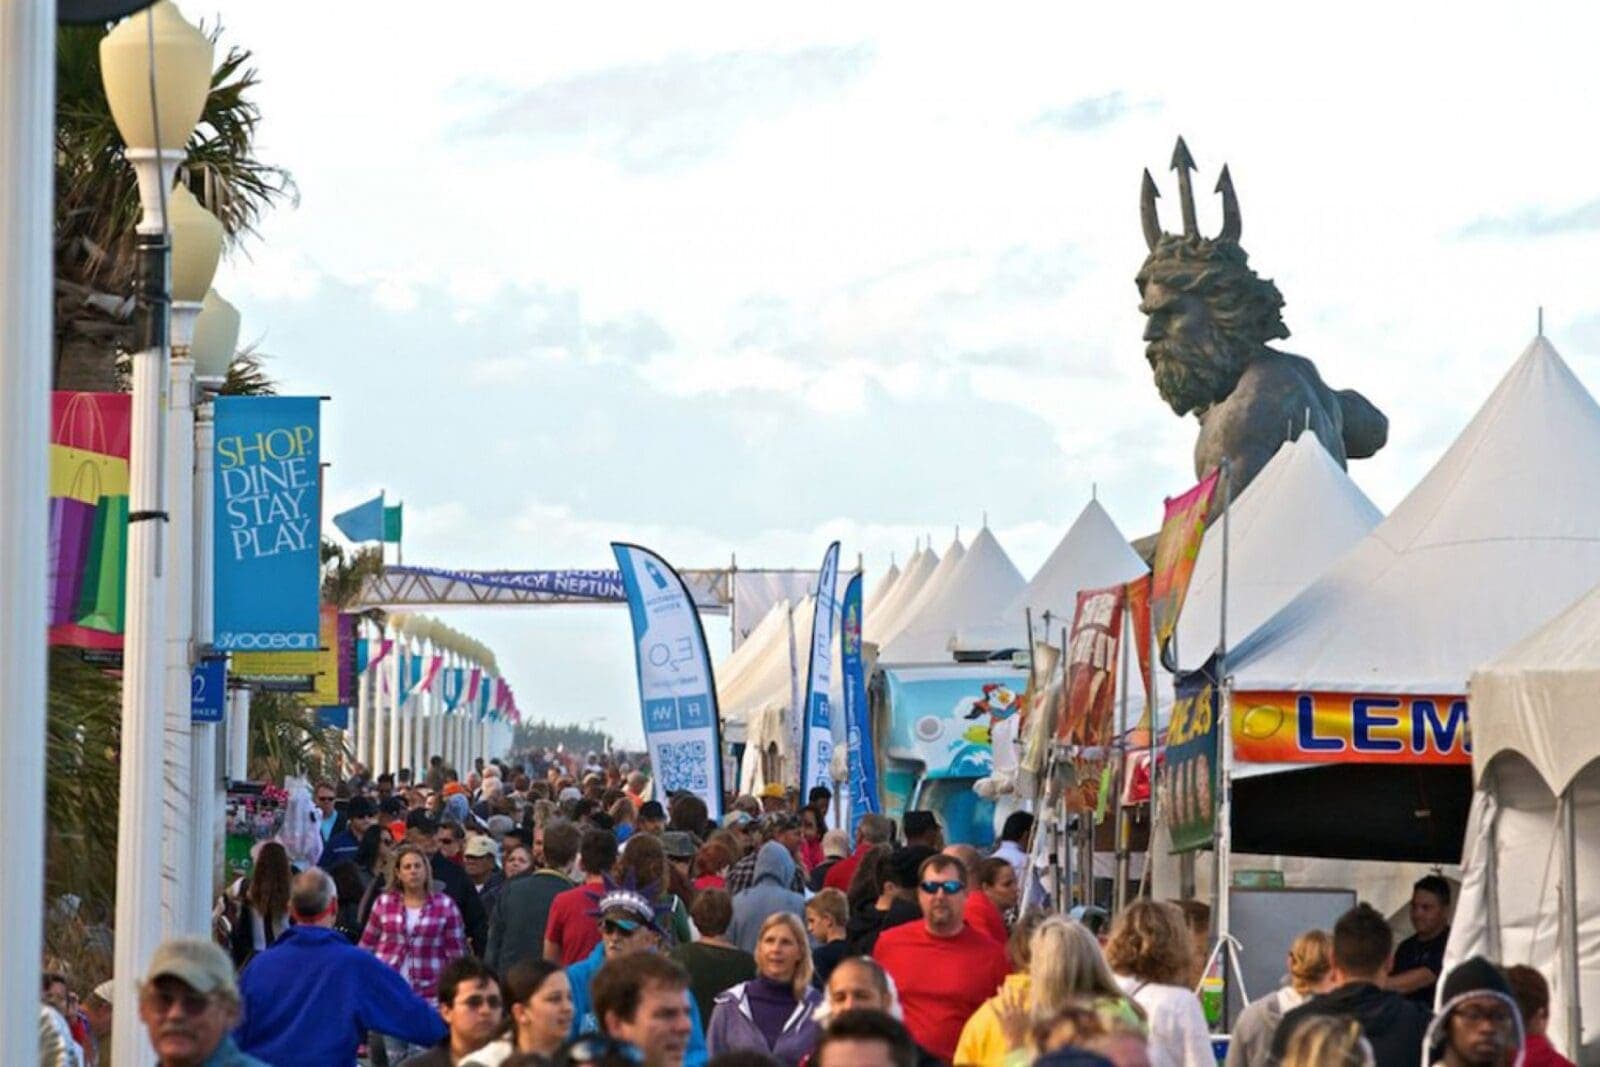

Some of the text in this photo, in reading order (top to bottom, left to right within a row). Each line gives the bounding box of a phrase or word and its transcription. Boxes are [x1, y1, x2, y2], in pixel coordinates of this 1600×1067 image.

[222, 457, 316, 499] DINE.
[226, 488, 309, 529] STAY.
[231, 519, 313, 560] PLAY.
[554, 577, 627, 599] NEPTUN
[1297, 694, 1471, 755] LEM
